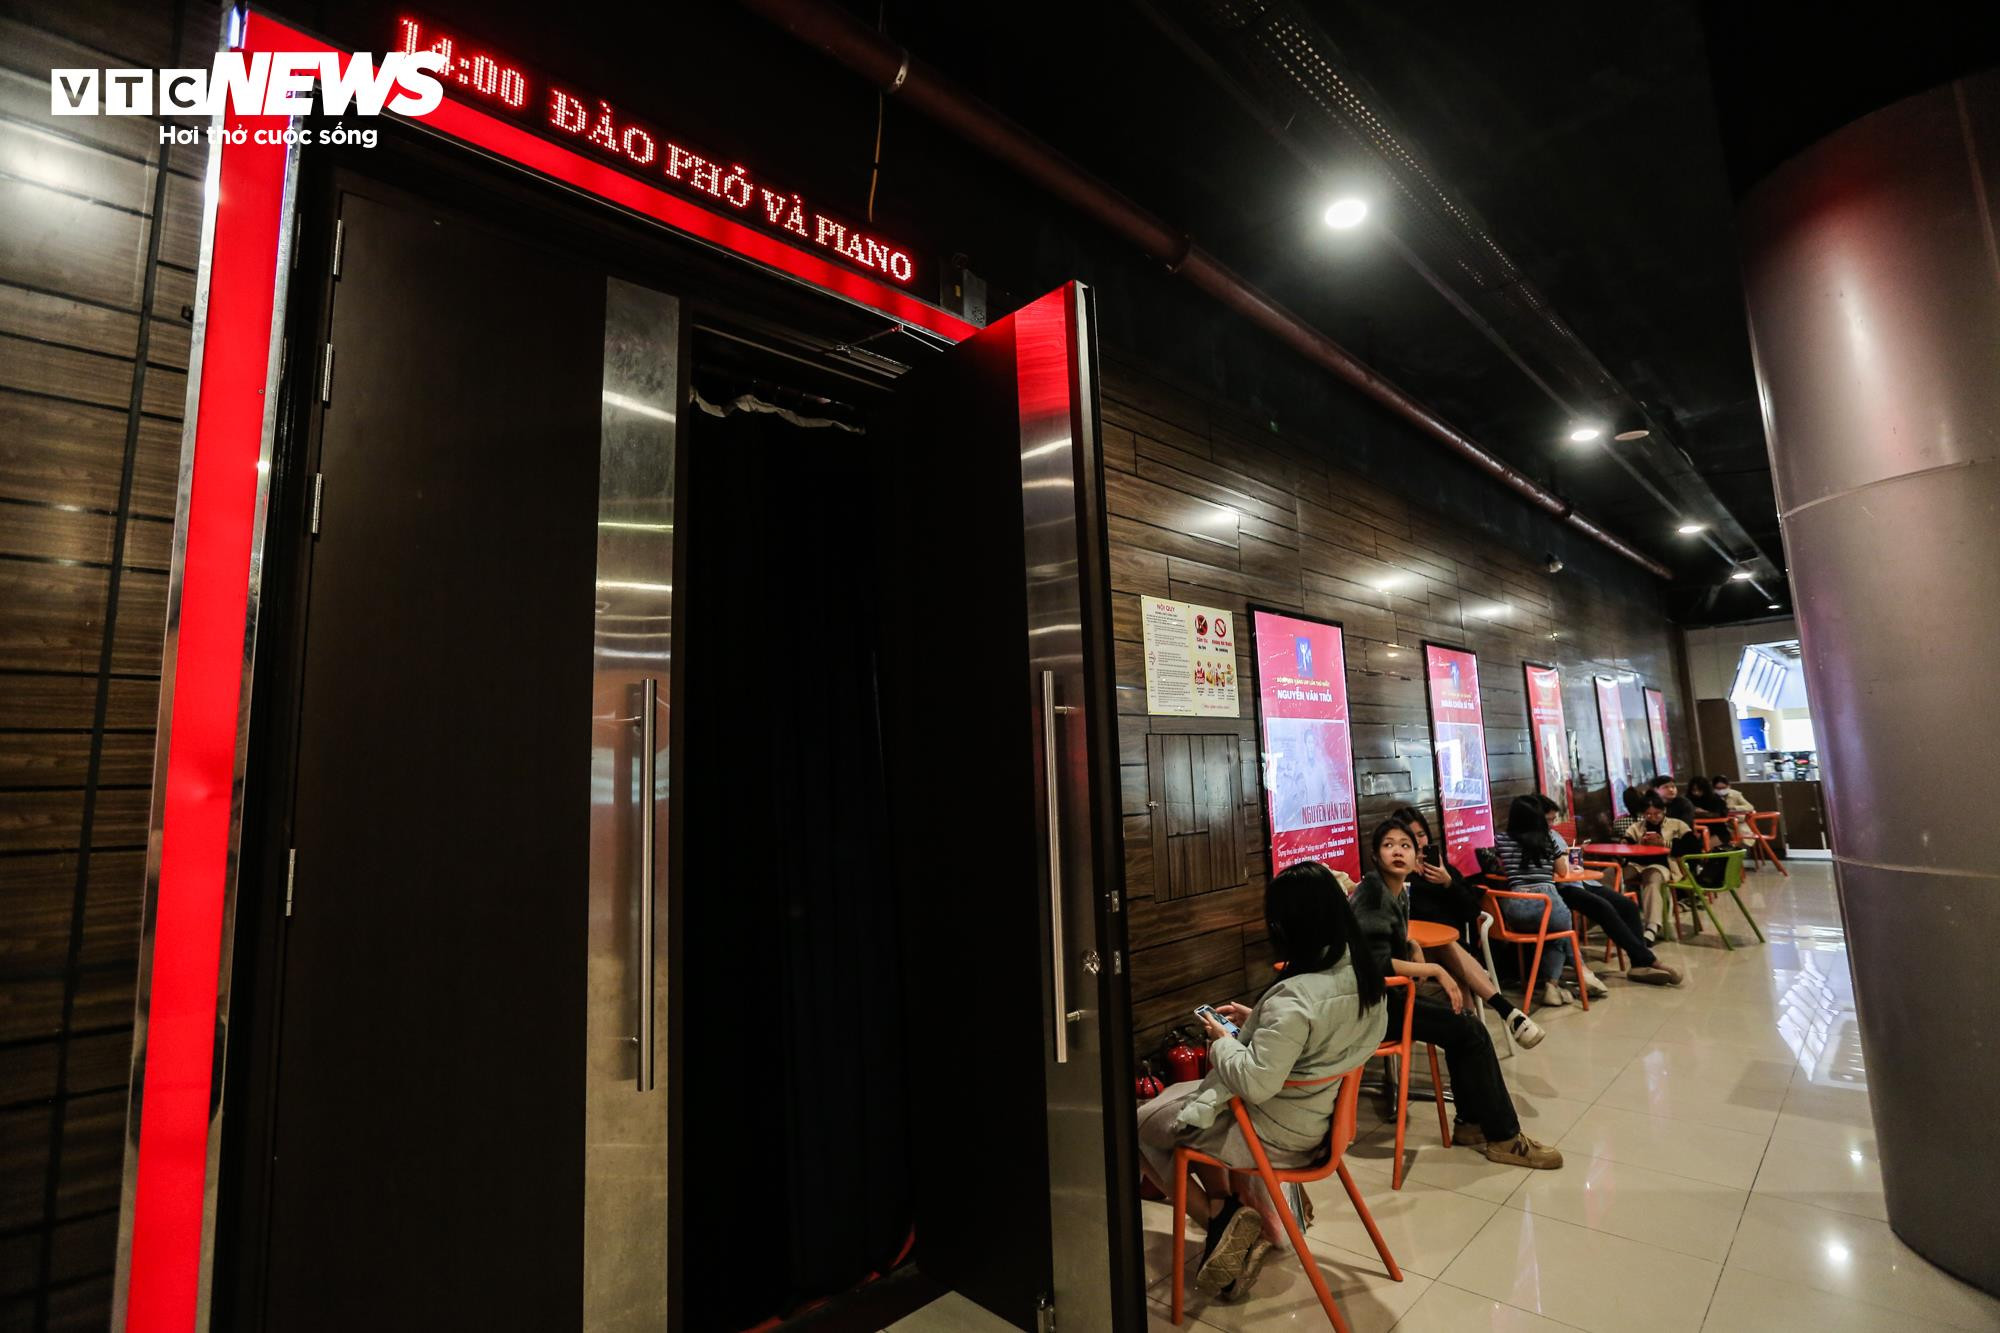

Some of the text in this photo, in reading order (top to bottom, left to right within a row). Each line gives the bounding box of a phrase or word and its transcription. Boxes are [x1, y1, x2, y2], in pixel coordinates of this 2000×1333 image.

[550, 88, 655, 164] ĐÀO
[761, 188, 809, 237] VÀ
[815, 214, 912, 282] PIANO
[1305, 689, 1318, 702] VĂN
